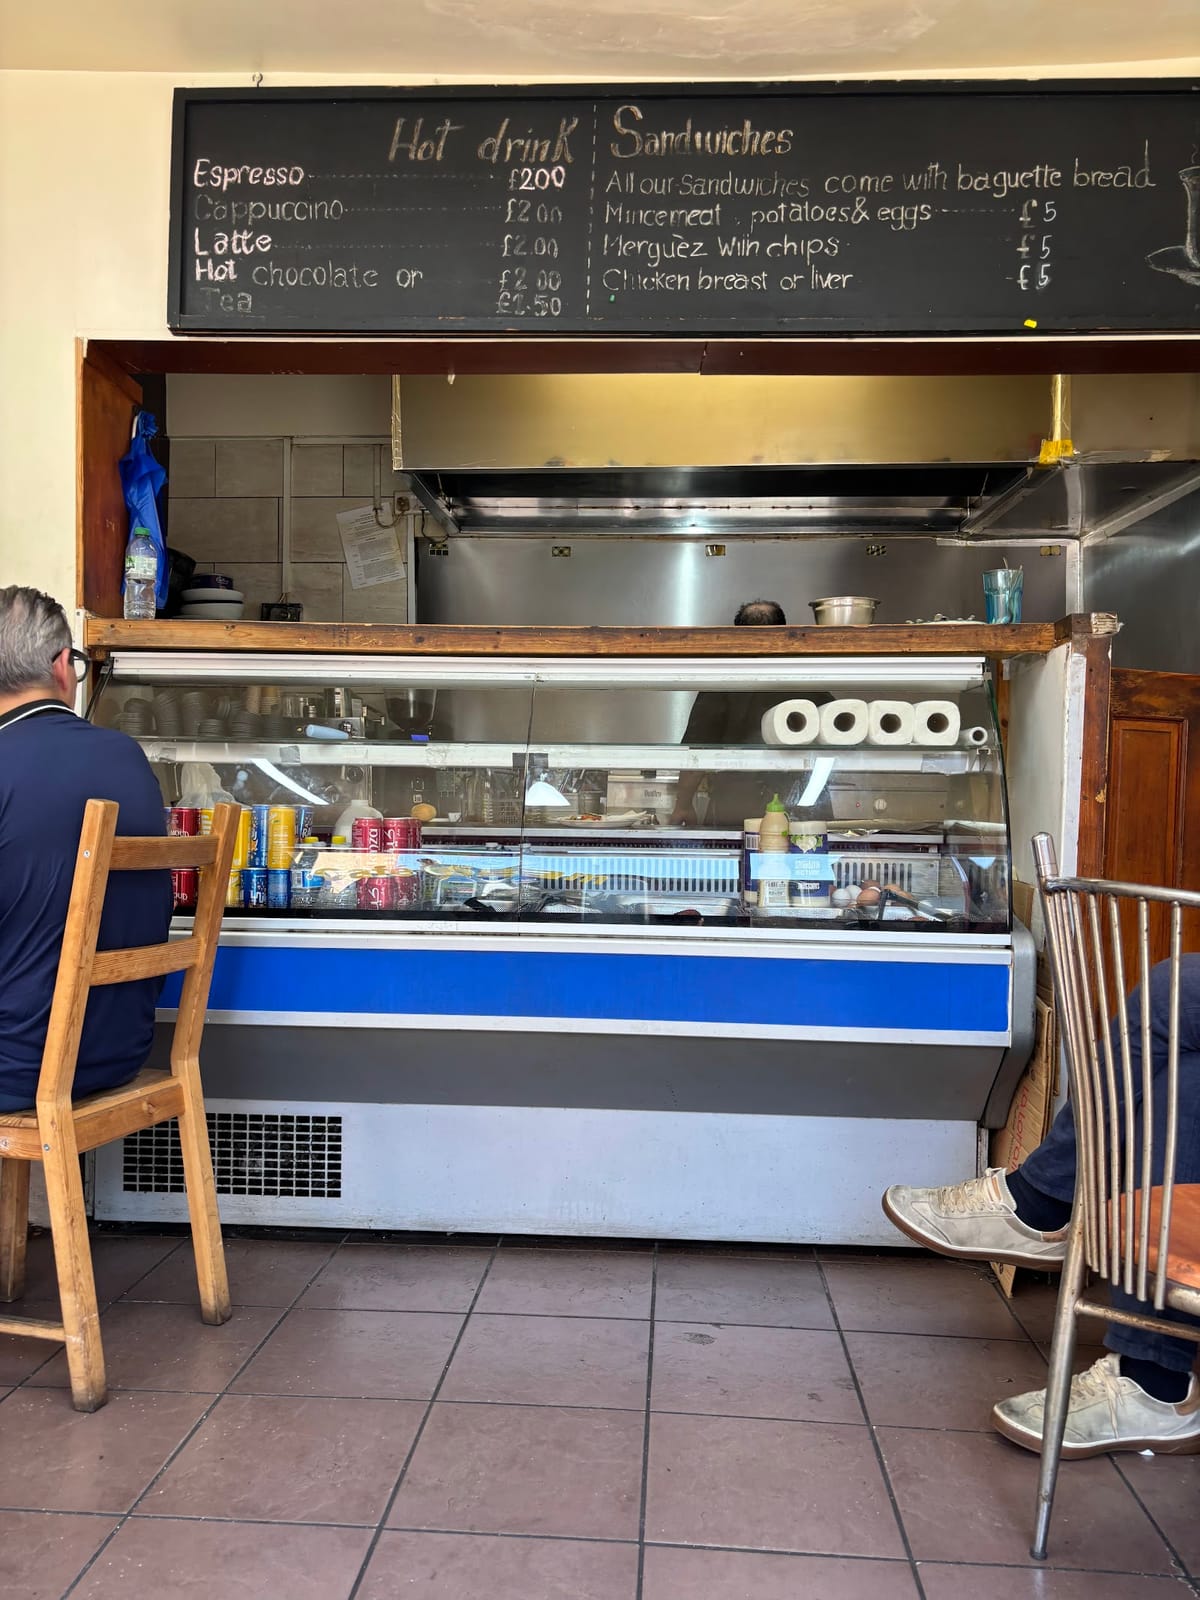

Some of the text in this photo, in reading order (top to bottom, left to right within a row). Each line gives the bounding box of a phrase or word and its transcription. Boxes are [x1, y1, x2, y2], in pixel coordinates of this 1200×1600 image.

[388, 117, 464, 162] Hot
[610, 105, 794, 158] Sandwiches
[194, 158, 304, 192] Espresso
[606, 170, 635, 193] All
[639, 178, 674, 195] our
[824, 175, 894, 193] come
[903, 162, 948, 190] with
[958, 163, 1063, 198] baguette
[1073, 139, 1157, 189] bread
[194, 194, 344, 225] Cappuccino
[877, 204, 932, 230] eggs
[194, 227, 272, 255] Latte
[766, 233, 840, 266] chips
[195, 258, 238, 281] Hot
[252, 260, 379, 288] chocolate
[396, 268, 423, 288] or
[698, 266, 768, 290] breast
[779, 273, 804, 290] or
[811, 264, 854, 289] liver
[200, 287, 252, 313] Tea
